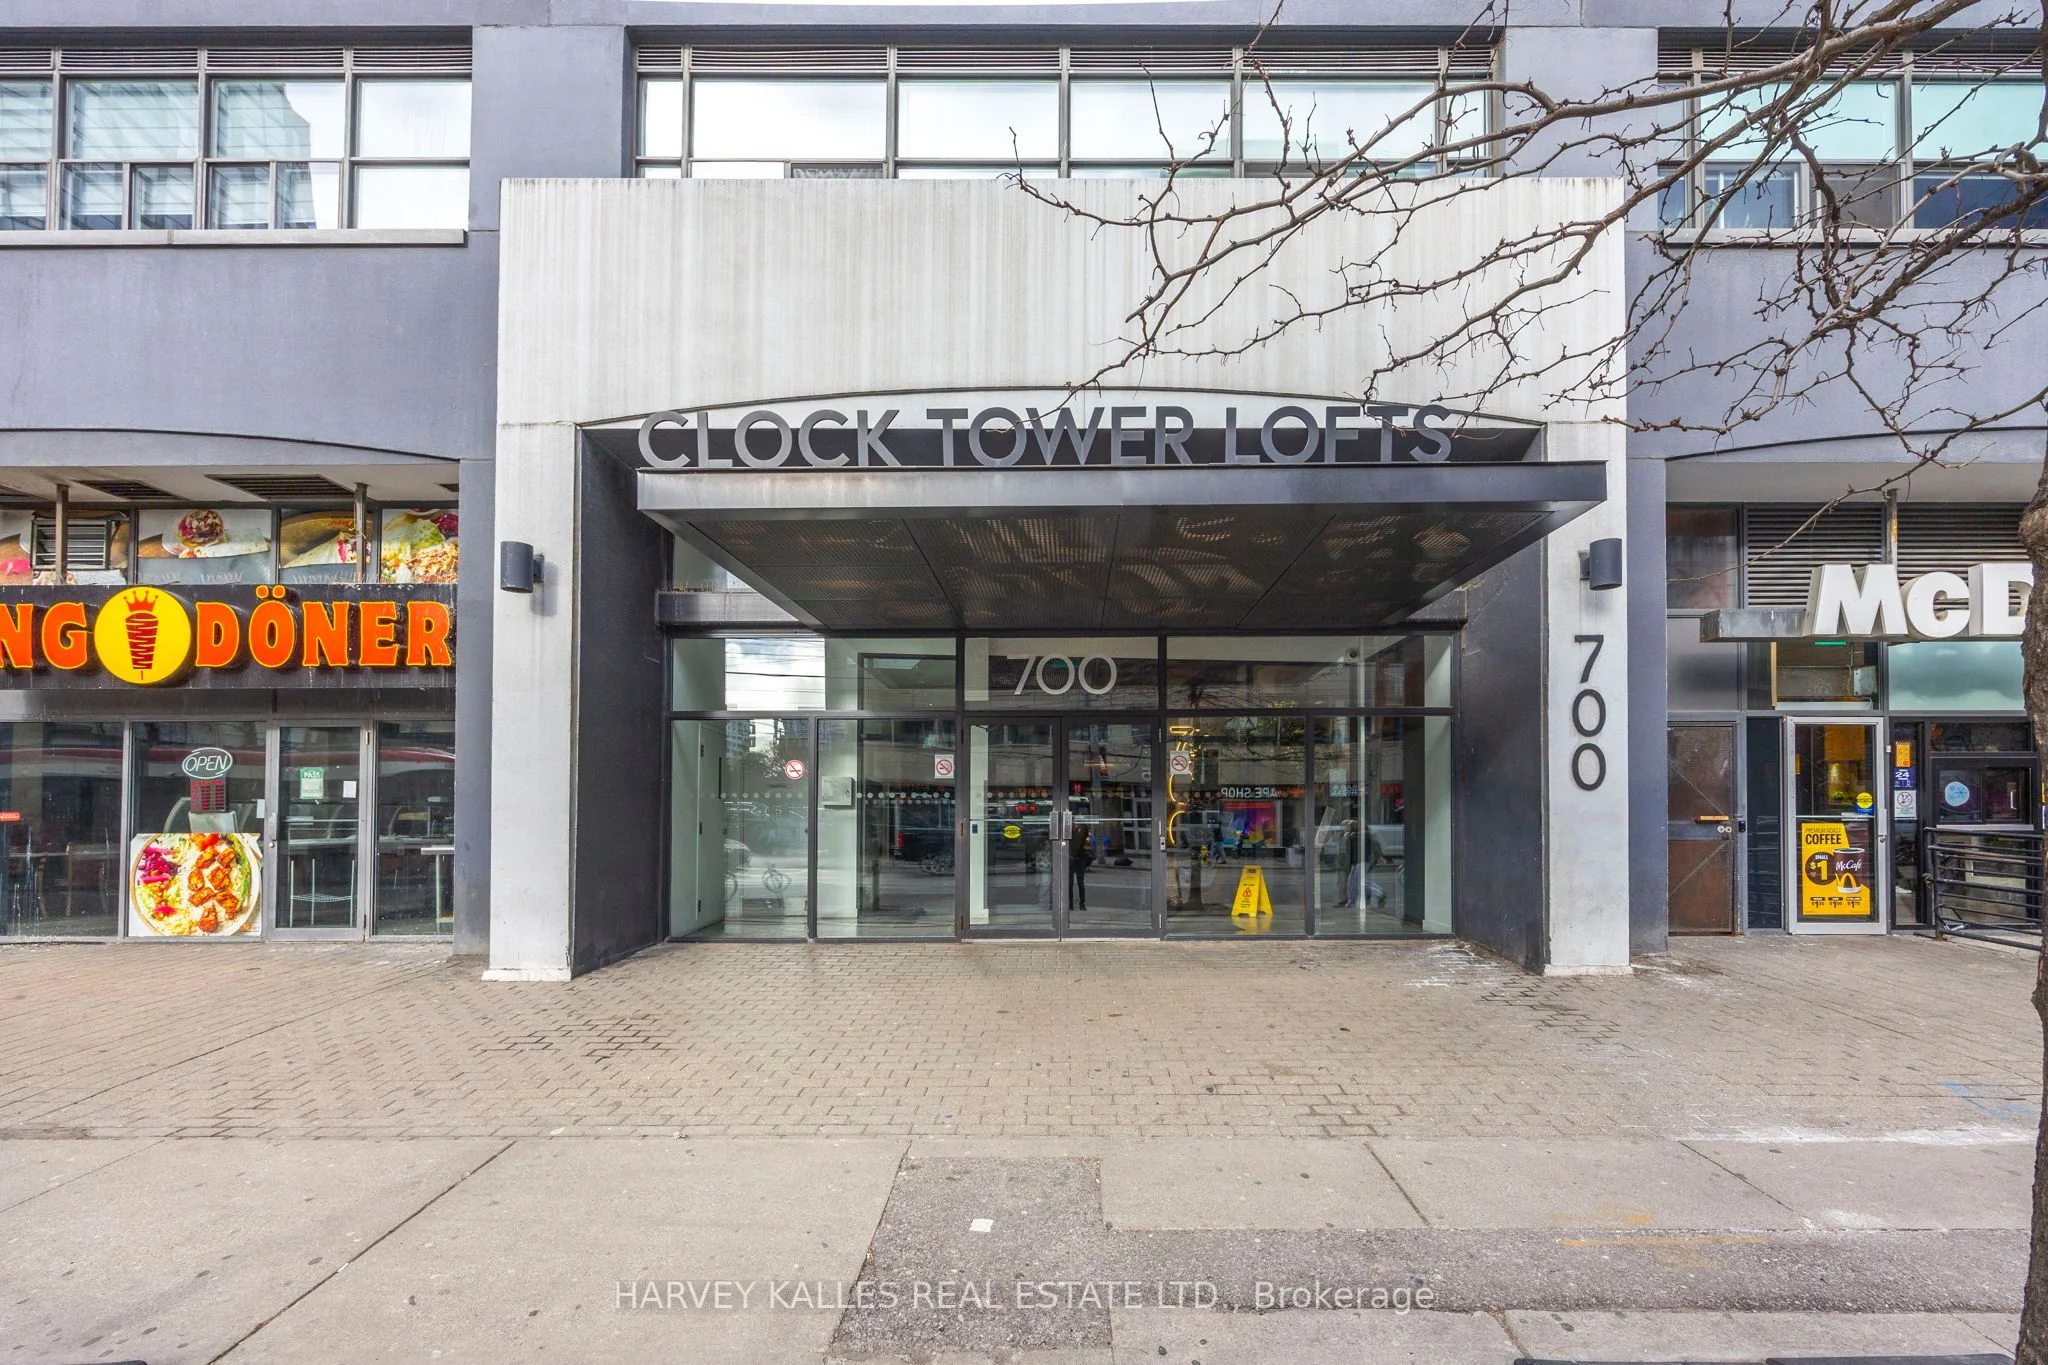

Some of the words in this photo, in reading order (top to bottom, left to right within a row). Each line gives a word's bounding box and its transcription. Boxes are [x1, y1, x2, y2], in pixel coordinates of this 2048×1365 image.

[638, 409, 901, 468] CLOCK
[926, 405, 1194, 467] TOWER
[1225, 404, 1452, 464] LOFTS
[196, 585, 452, 668] DÖNER
[1007, 653, 1117, 695] 700
[1572, 634, 1606, 791] 700
[185, 755, 227, 772] OPEN
[1805, 833, 1842, 845] COFFEE
